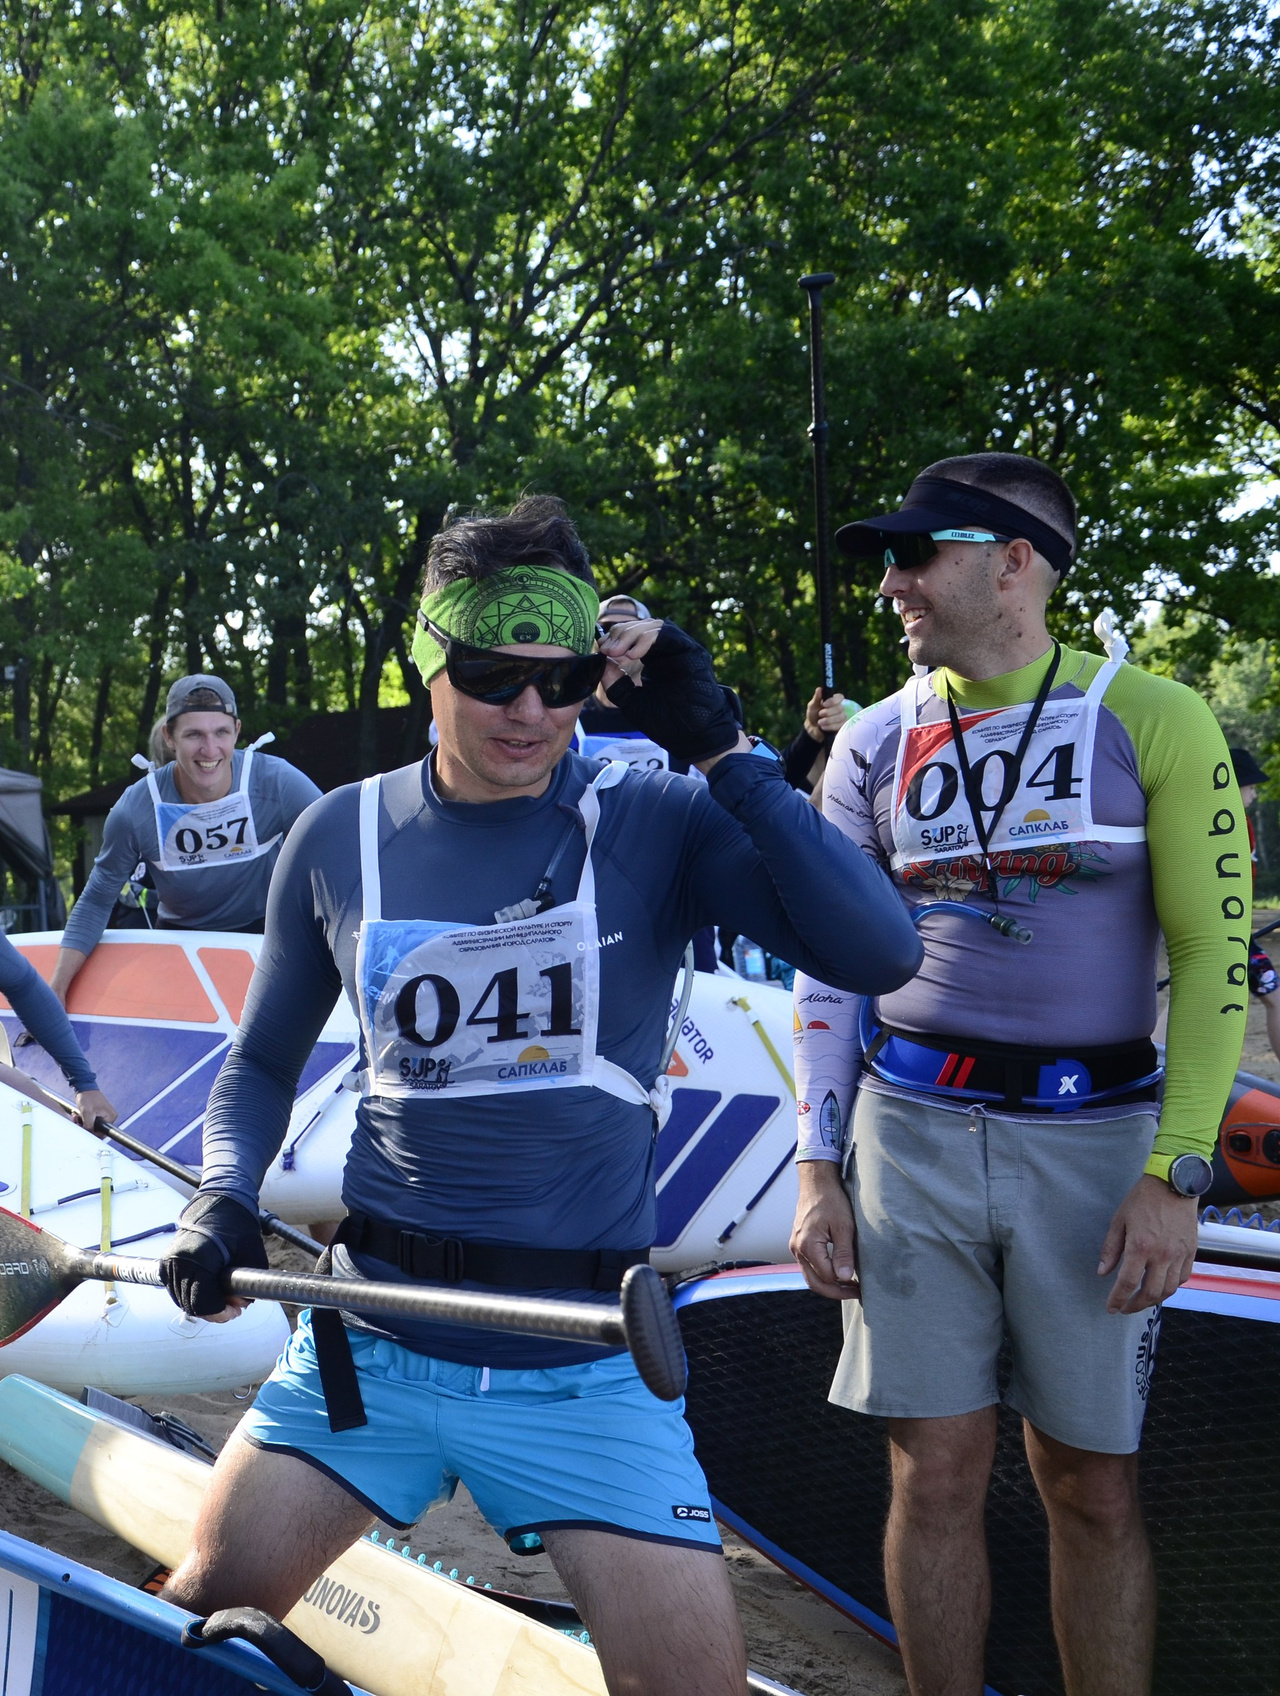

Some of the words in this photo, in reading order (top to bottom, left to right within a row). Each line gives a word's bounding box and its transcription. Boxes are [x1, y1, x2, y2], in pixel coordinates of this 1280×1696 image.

[906, 742, 1084, 821] 004
[175, 816, 249, 854] 057
[921, 826, 956, 846] SUP
[1009, 820, 1069, 836] САПКЛАБ
[934, 844, 964, 853] SARATOV
[452, 935, 505, 946] АДМИНИСТРАЦИИ
[506, 929, 562, 940] МУНИЦИПАЛЬНОГО
[467, 930, 477, 938] ПО
[477, 926, 517, 937] ФИЗИЧЕСКОЙ
[517, 923, 544, 931] КУЛЬТУРЕ
[550, 920, 573, 928] СПОРТУ
[459, 943, 501, 953] ОБРАЗОВАНИЯ
[394, 962, 582, 1048] 041
[799, 993, 844, 1005] Aloha
[399, 1057, 437, 1079] SUP
[497, 1061, 567, 1079] САПКЛАБ
[689, 1510, 709, 1518] JOSS
